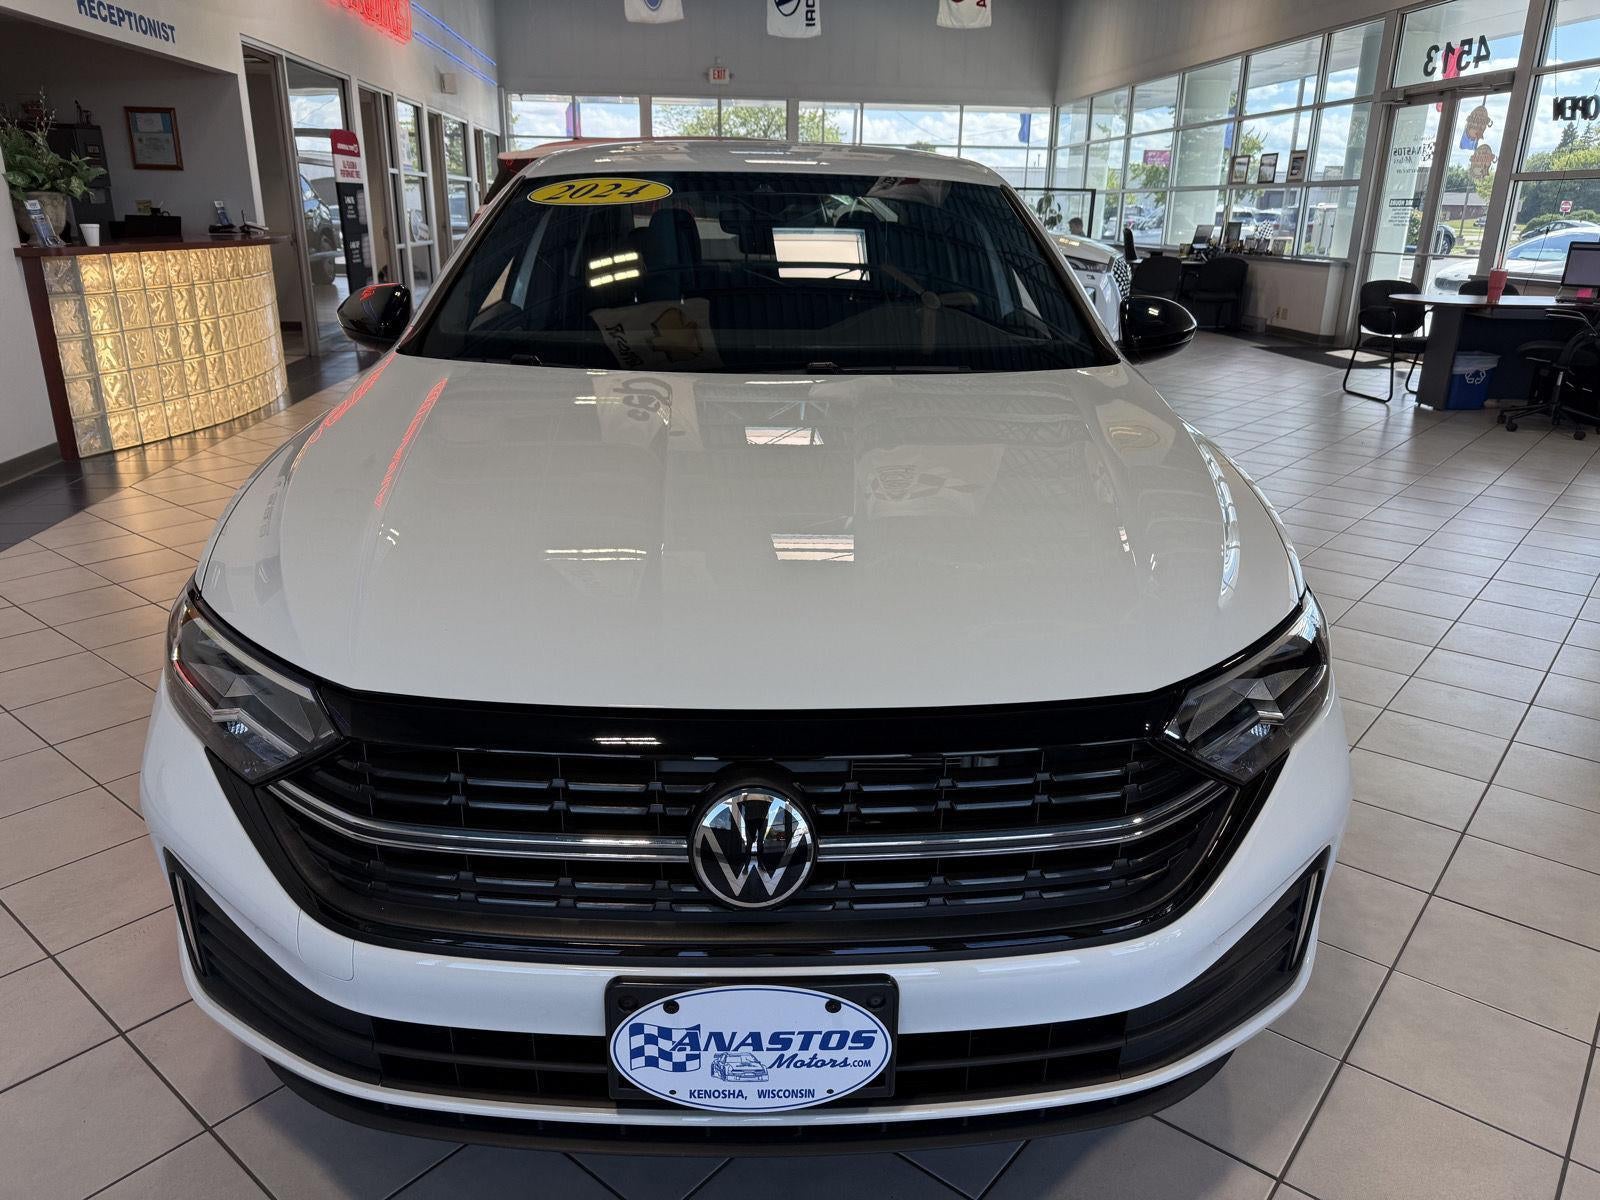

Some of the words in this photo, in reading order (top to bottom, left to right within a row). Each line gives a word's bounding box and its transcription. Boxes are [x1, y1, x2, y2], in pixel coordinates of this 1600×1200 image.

[76, 0, 176, 43] RECEPTIONIST
[712, 68, 727, 80] EXIT
[543, 183, 651, 201] 2024
[670, 1029, 877, 1052] ANASTOS
[689, 1089, 748, 1101] KENOSHA,
[757, 1088, 815, 1099] WISCONSIN
